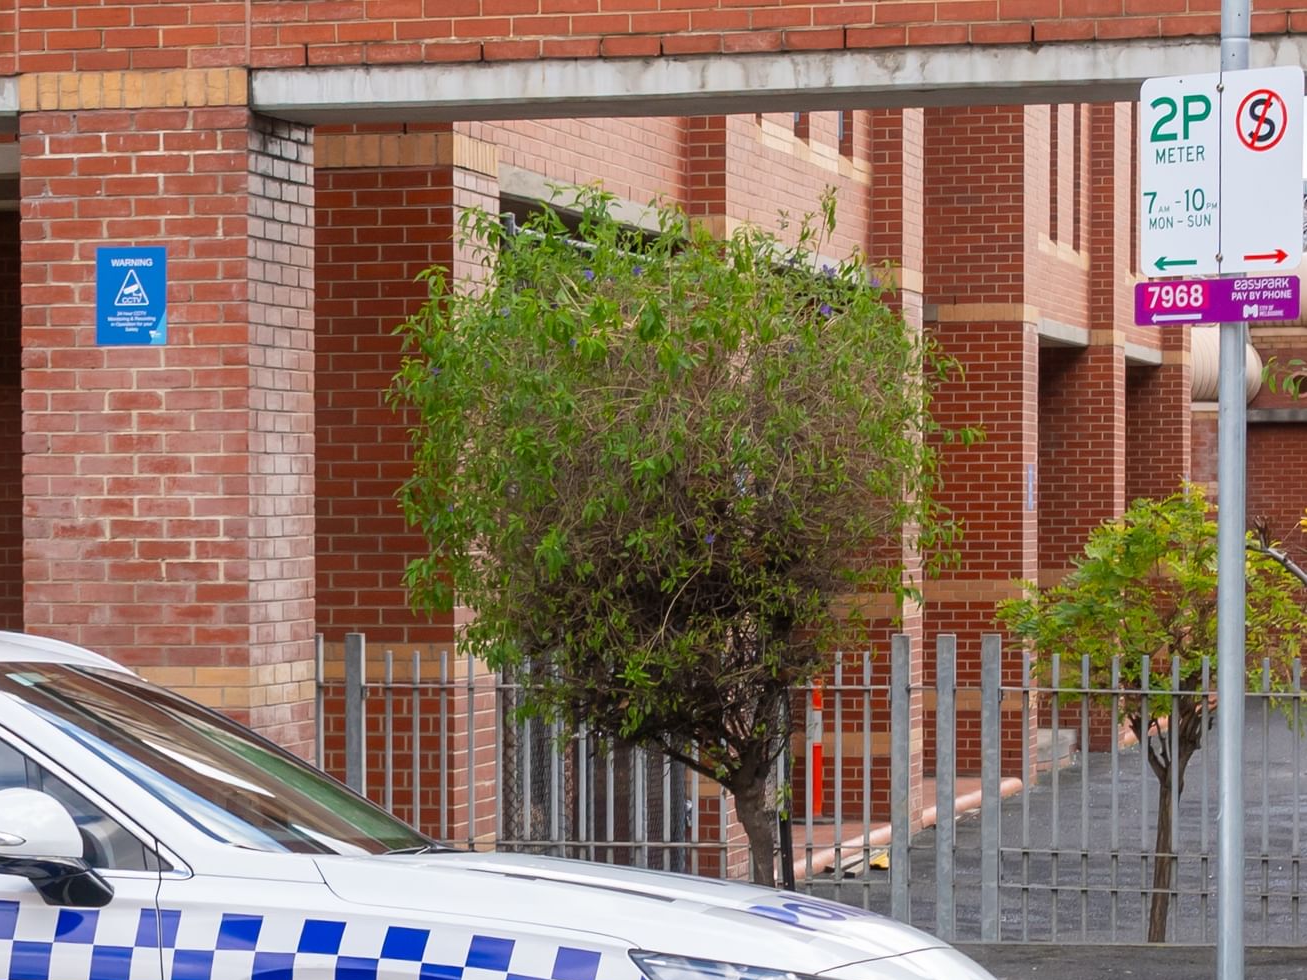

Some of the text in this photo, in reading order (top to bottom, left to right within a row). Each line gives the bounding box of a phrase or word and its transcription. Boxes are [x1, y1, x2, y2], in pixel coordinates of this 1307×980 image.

[1149, 94, 1212, 142] 2P
[1155, 145, 1205, 165] METER
[1149, 215, 1174, 230] MON
[1187, 213, 1212, 228] SUN
[111, 258, 153, 267] WARNING
[1147, 284, 1204, 309] 7968
[1231, 289, 1292, 301] PAY BY PHONE
